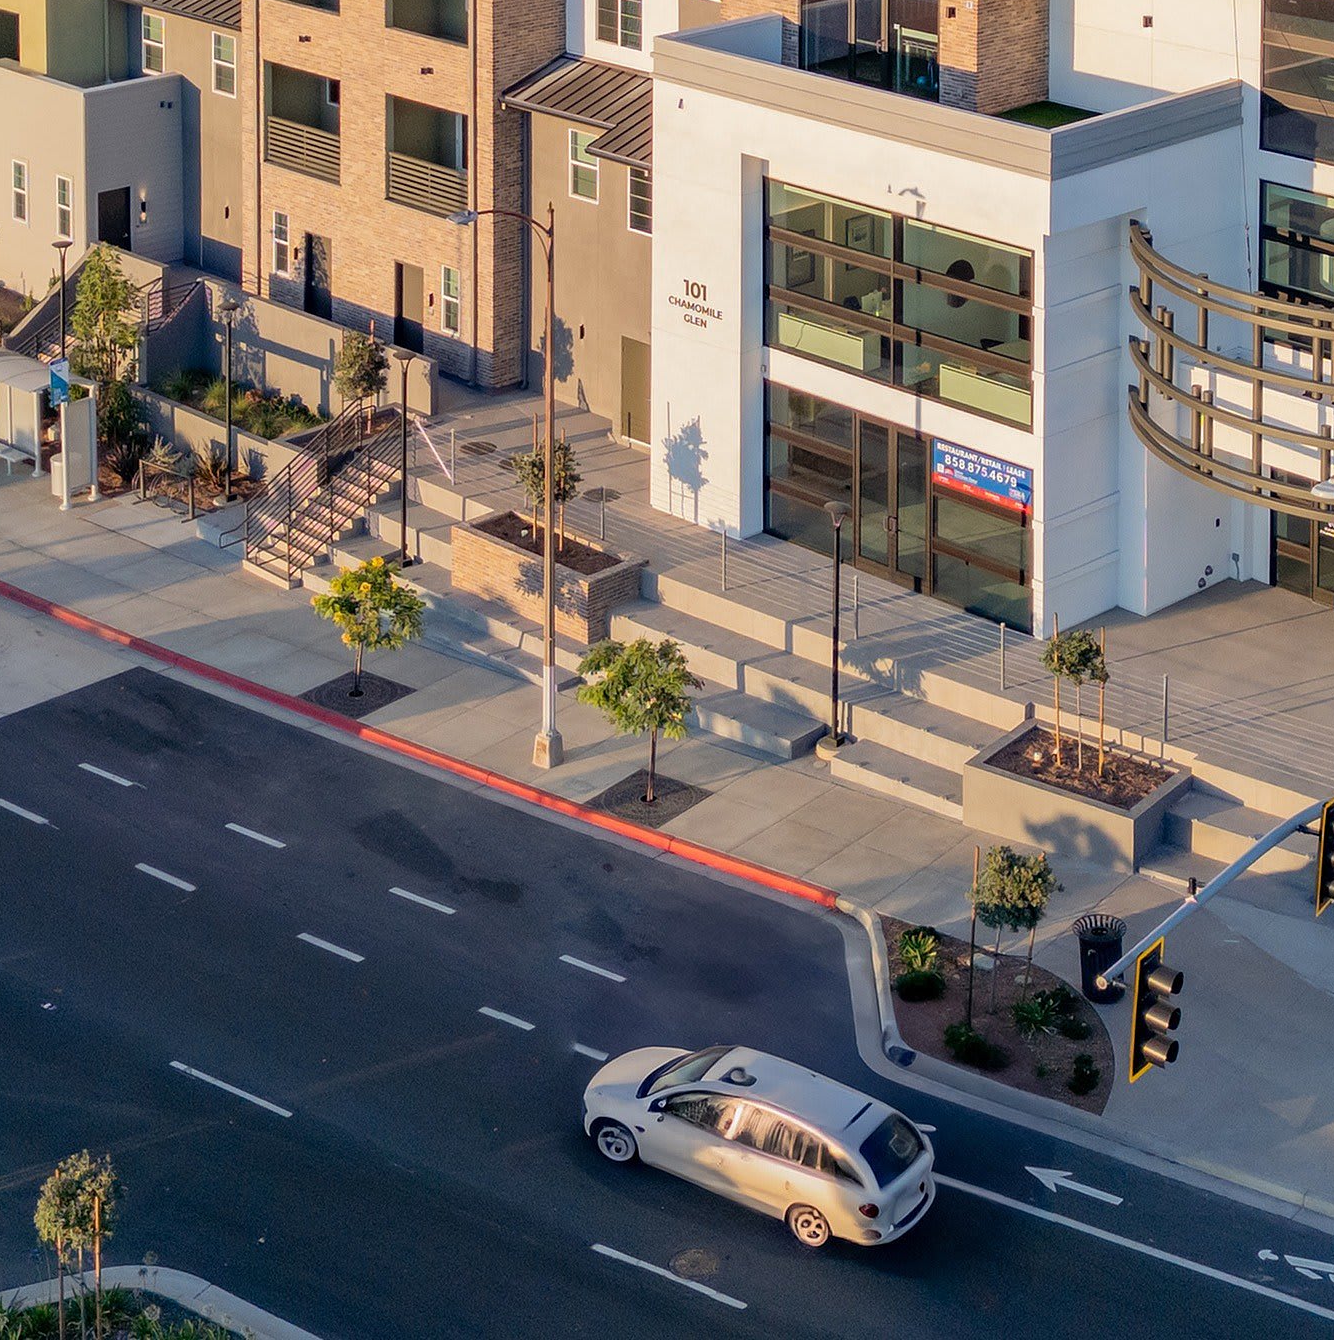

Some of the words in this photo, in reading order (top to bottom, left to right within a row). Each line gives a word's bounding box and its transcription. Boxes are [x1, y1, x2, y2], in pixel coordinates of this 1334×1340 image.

[683, 279, 707, 301] 101
[668, 295, 723, 320] CHAMOMILE
[683, 313, 707, 328] GLEN
[945, 454, 1017, 487] 858.875.4679
